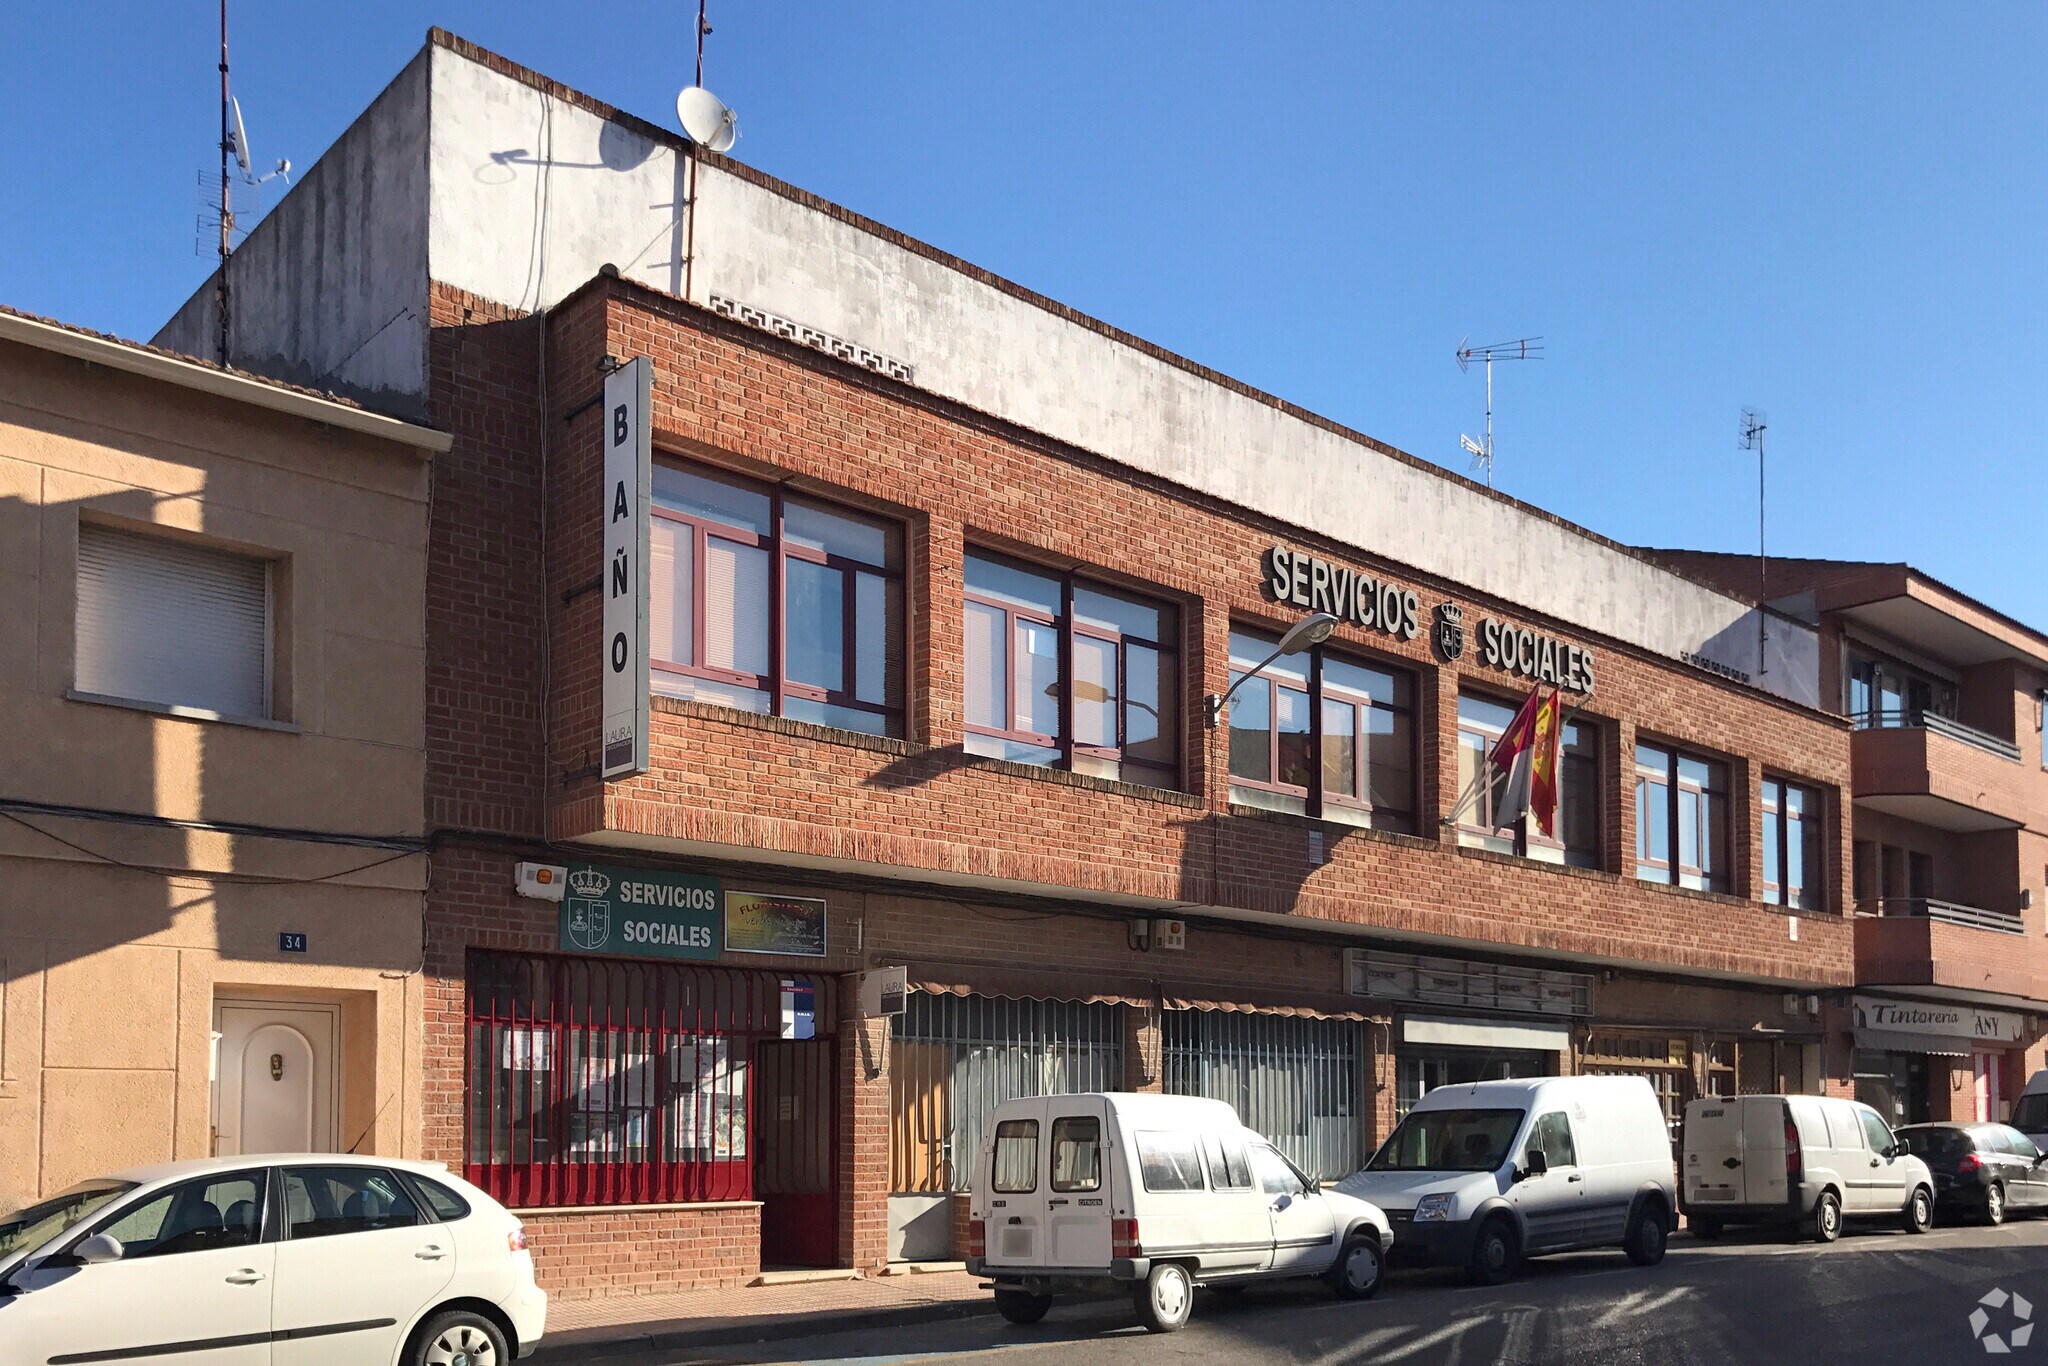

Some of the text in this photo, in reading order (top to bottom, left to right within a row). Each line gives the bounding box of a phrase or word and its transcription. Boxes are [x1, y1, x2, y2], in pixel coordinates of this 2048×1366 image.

[611, 403, 629, 674] BAÑO
[1272, 545, 1595, 693] SERVICIOS SOCIALES
[605, 725, 633, 744] LAURA
[620, 880, 715, 911] SERVICIOS
[286, 935, 300, 949] 34
[623, 920, 712, 948] SOCIALES
[881, 981, 904, 994] LAURA
